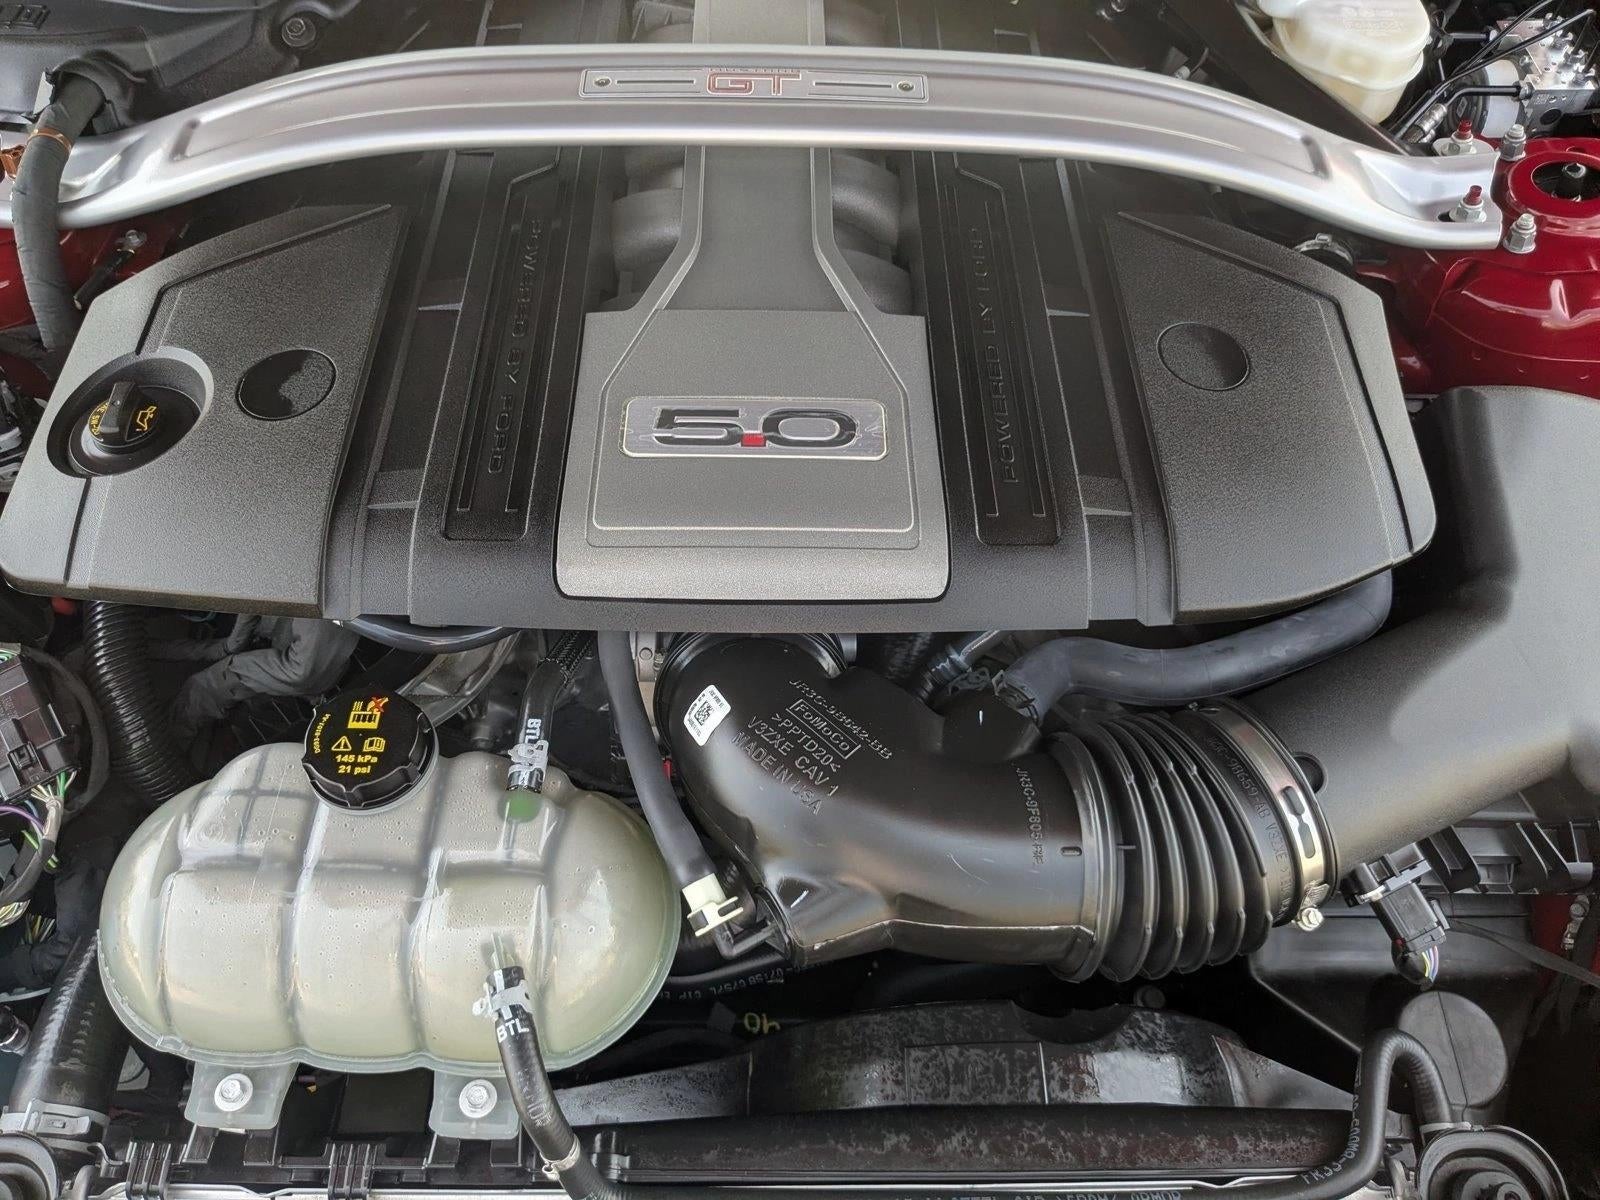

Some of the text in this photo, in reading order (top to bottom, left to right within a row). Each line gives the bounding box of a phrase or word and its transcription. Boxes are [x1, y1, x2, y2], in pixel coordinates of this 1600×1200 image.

[707, 73, 802, 95] GT
[488, 395, 513, 475] FORD
[652, 406, 862, 449] 5.0
[984, 345, 1020, 484] POWERED
[525, 718, 542, 744] BTL
[795, 703, 850, 751] FoMoCo
[335, 754, 378, 763] 145 kPa
[338, 765, 372, 775] 21 psi
[730, 730, 823, 815] MADE IN USA
[747, 715, 840, 797] V3ZXE CAV 1
[496, 1018, 530, 1044] BTL
